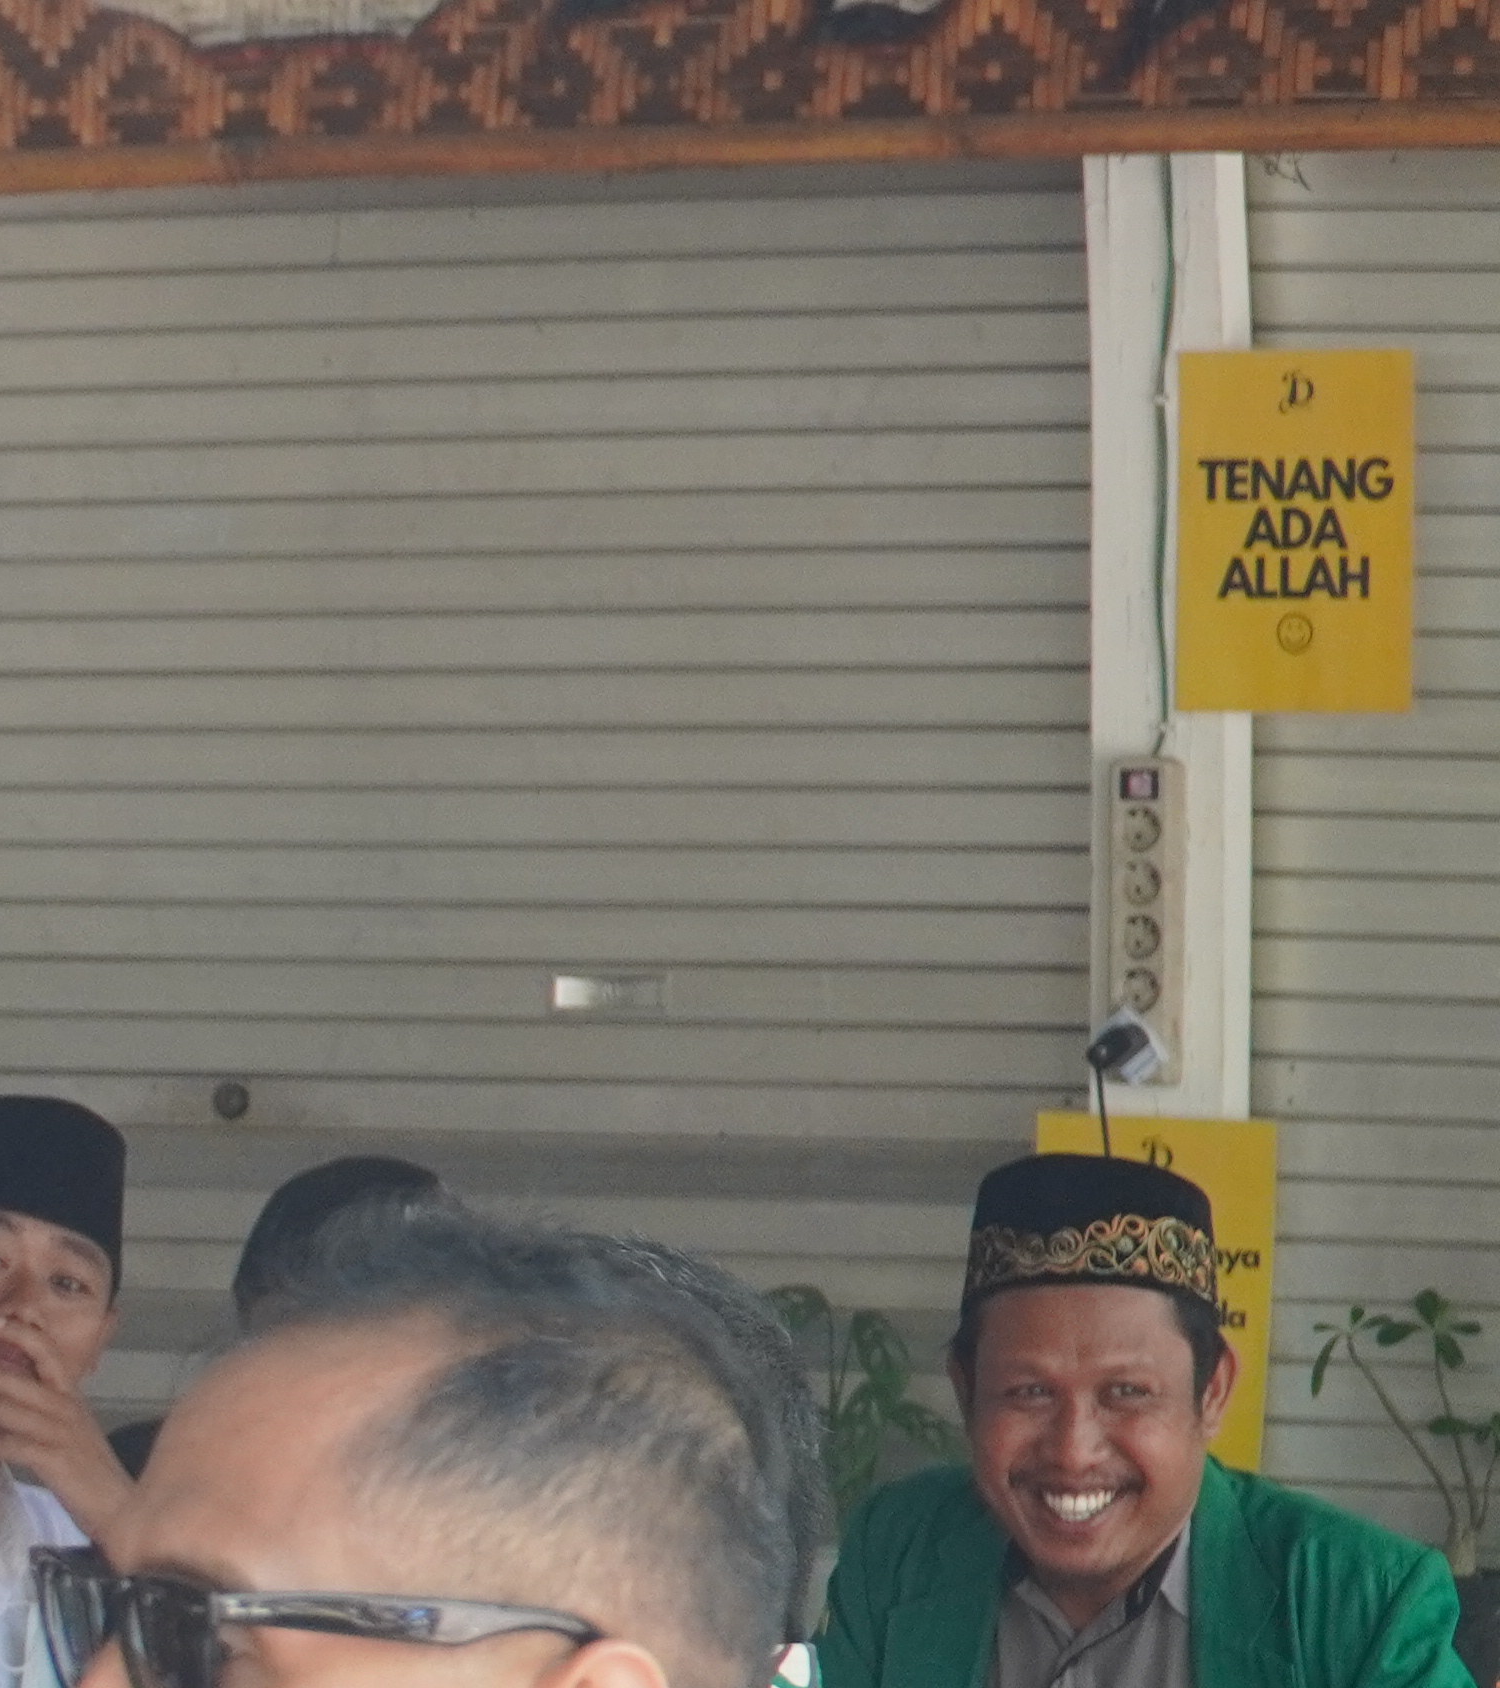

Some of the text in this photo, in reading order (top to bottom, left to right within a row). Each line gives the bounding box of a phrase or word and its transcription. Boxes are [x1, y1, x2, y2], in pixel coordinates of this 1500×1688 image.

[1197, 456, 1395, 502] TENANG
[1244, 506, 1348, 550] ADA
[1217, 555, 1370, 600] ALLAH
